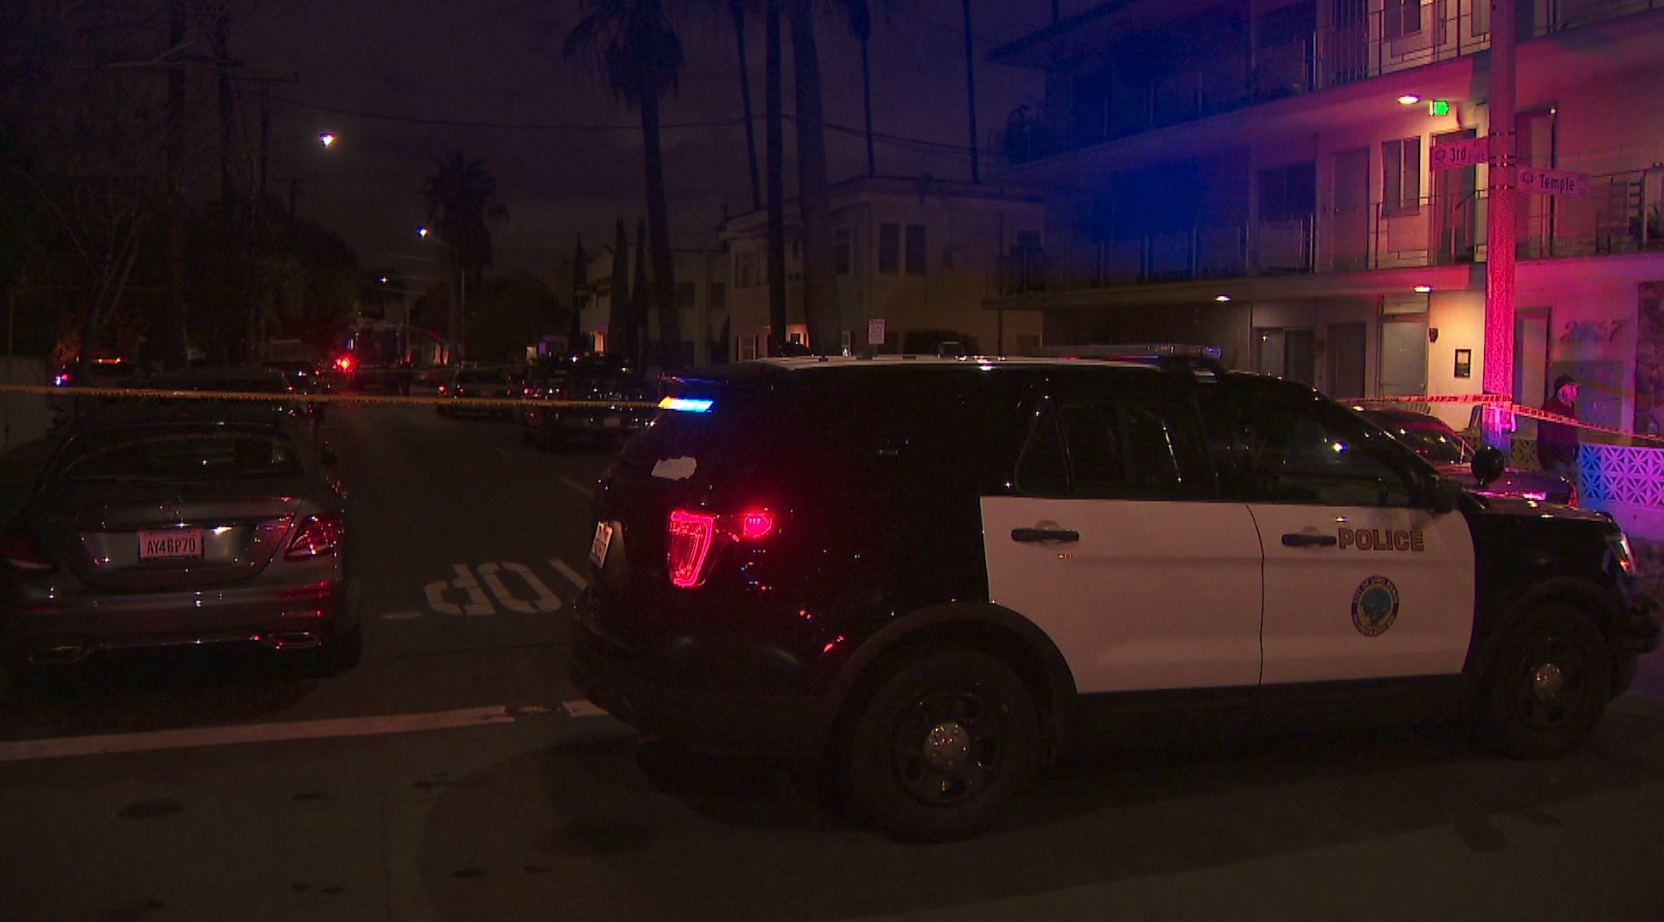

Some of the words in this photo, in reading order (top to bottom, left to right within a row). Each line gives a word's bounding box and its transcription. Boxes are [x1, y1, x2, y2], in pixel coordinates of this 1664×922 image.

[1450, 146, 1466, 162] 3rd
[1540, 173, 1575, 194] Temple
[1337, 529, 1424, 551] POLICE
